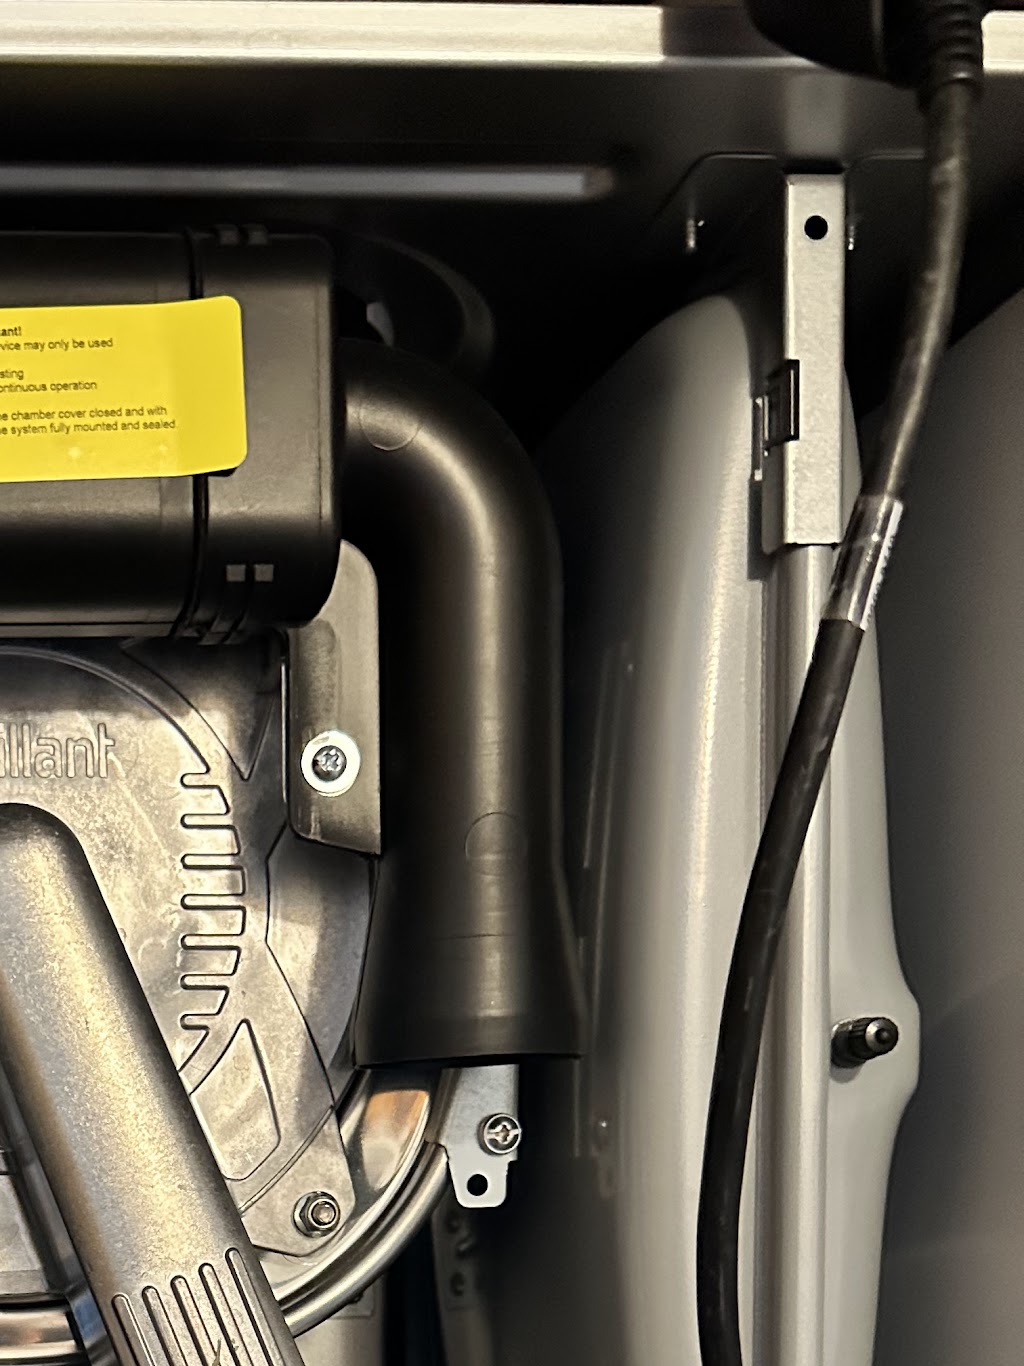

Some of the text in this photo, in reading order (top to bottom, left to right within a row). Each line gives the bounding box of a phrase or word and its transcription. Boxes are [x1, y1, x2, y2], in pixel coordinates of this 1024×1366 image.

[24, 342, 46, 352] may
[48, 339, 69, 352] only
[72, 338, 85, 349] be
[87, 338, 113, 349] used
[49, 380, 98, 394] operation
[10, 410, 56, 422] chamber
[58, 410, 87, 420] cover
[89, 407, 123, 418] closed
[125, 406, 144, 417] and
[147, 405, 168, 416] with
[10, 423, 47, 437] system
[49, 422, 71, 435] fully
[73, 420, 118, 432] mounted
[121, 420, 140, 431] and
